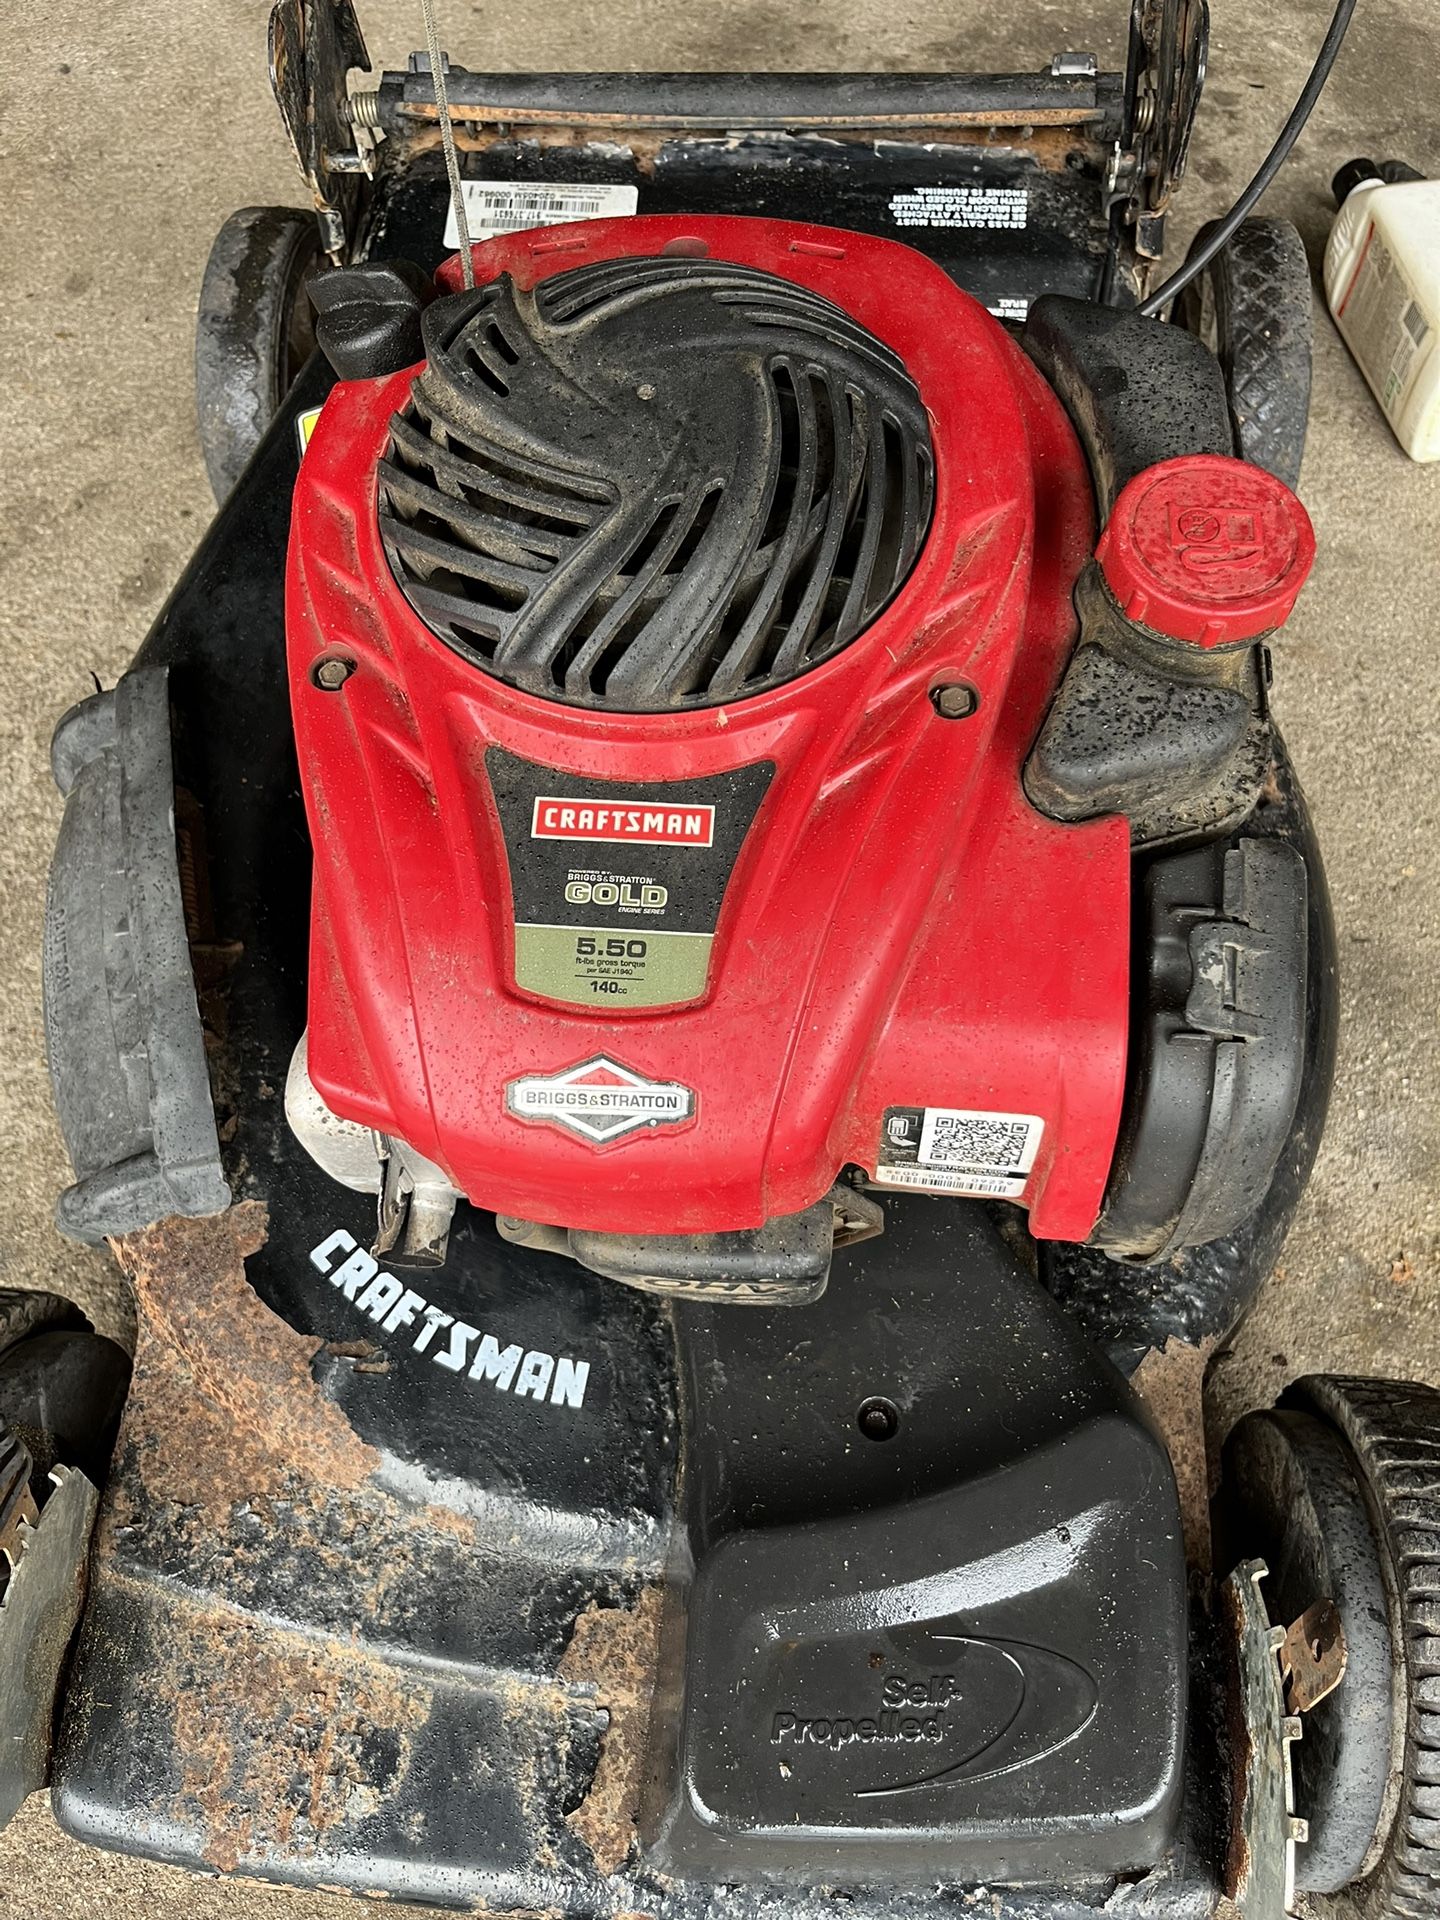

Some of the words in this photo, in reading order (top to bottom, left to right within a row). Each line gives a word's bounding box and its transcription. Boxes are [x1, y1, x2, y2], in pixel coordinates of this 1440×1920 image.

[971, 188, 983, 196] IS
[985, 189, 1028, 198] ENGINE
[893, 194, 924, 202] WHEN
[926, 195, 967, 204] CLOSED
[968, 196, 998, 205] DOOR
[1000, 197, 1028, 205] WITH
[888, 202, 944, 211] INSTALLED
[944, 204, 972, 212] PLUG
[974, 204, 1010, 213] MULCH
[893, 210, 952, 219] ATTACHED
[952, 212, 1010, 220] PROPERLY
[1011, 213, 1027, 221] BE
[895, 218, 929, 227] MUST
[931, 219, 985, 228] CATCHER
[987, 220, 1027, 229] GRASS
[544, 807, 702, 836] CRAFTSMAN
[564, 881, 668, 908] GOLD
[618, 906, 642, 914] ENGINE
[576, 937, 647, 958] 5.50
[576, 956, 594, 965] ft-lbs
[596, 959, 618, 967] gross
[620, 960, 646, 969] torque
[612, 968, 633, 976] J1940
[590, 980, 628, 994] 140cc
[526, 1090, 678, 1109] BRIGGS&STRATTON
[309, 1228, 591, 1409] CRAFTSMAN
[770, 1709, 946, 1752] Propelled
